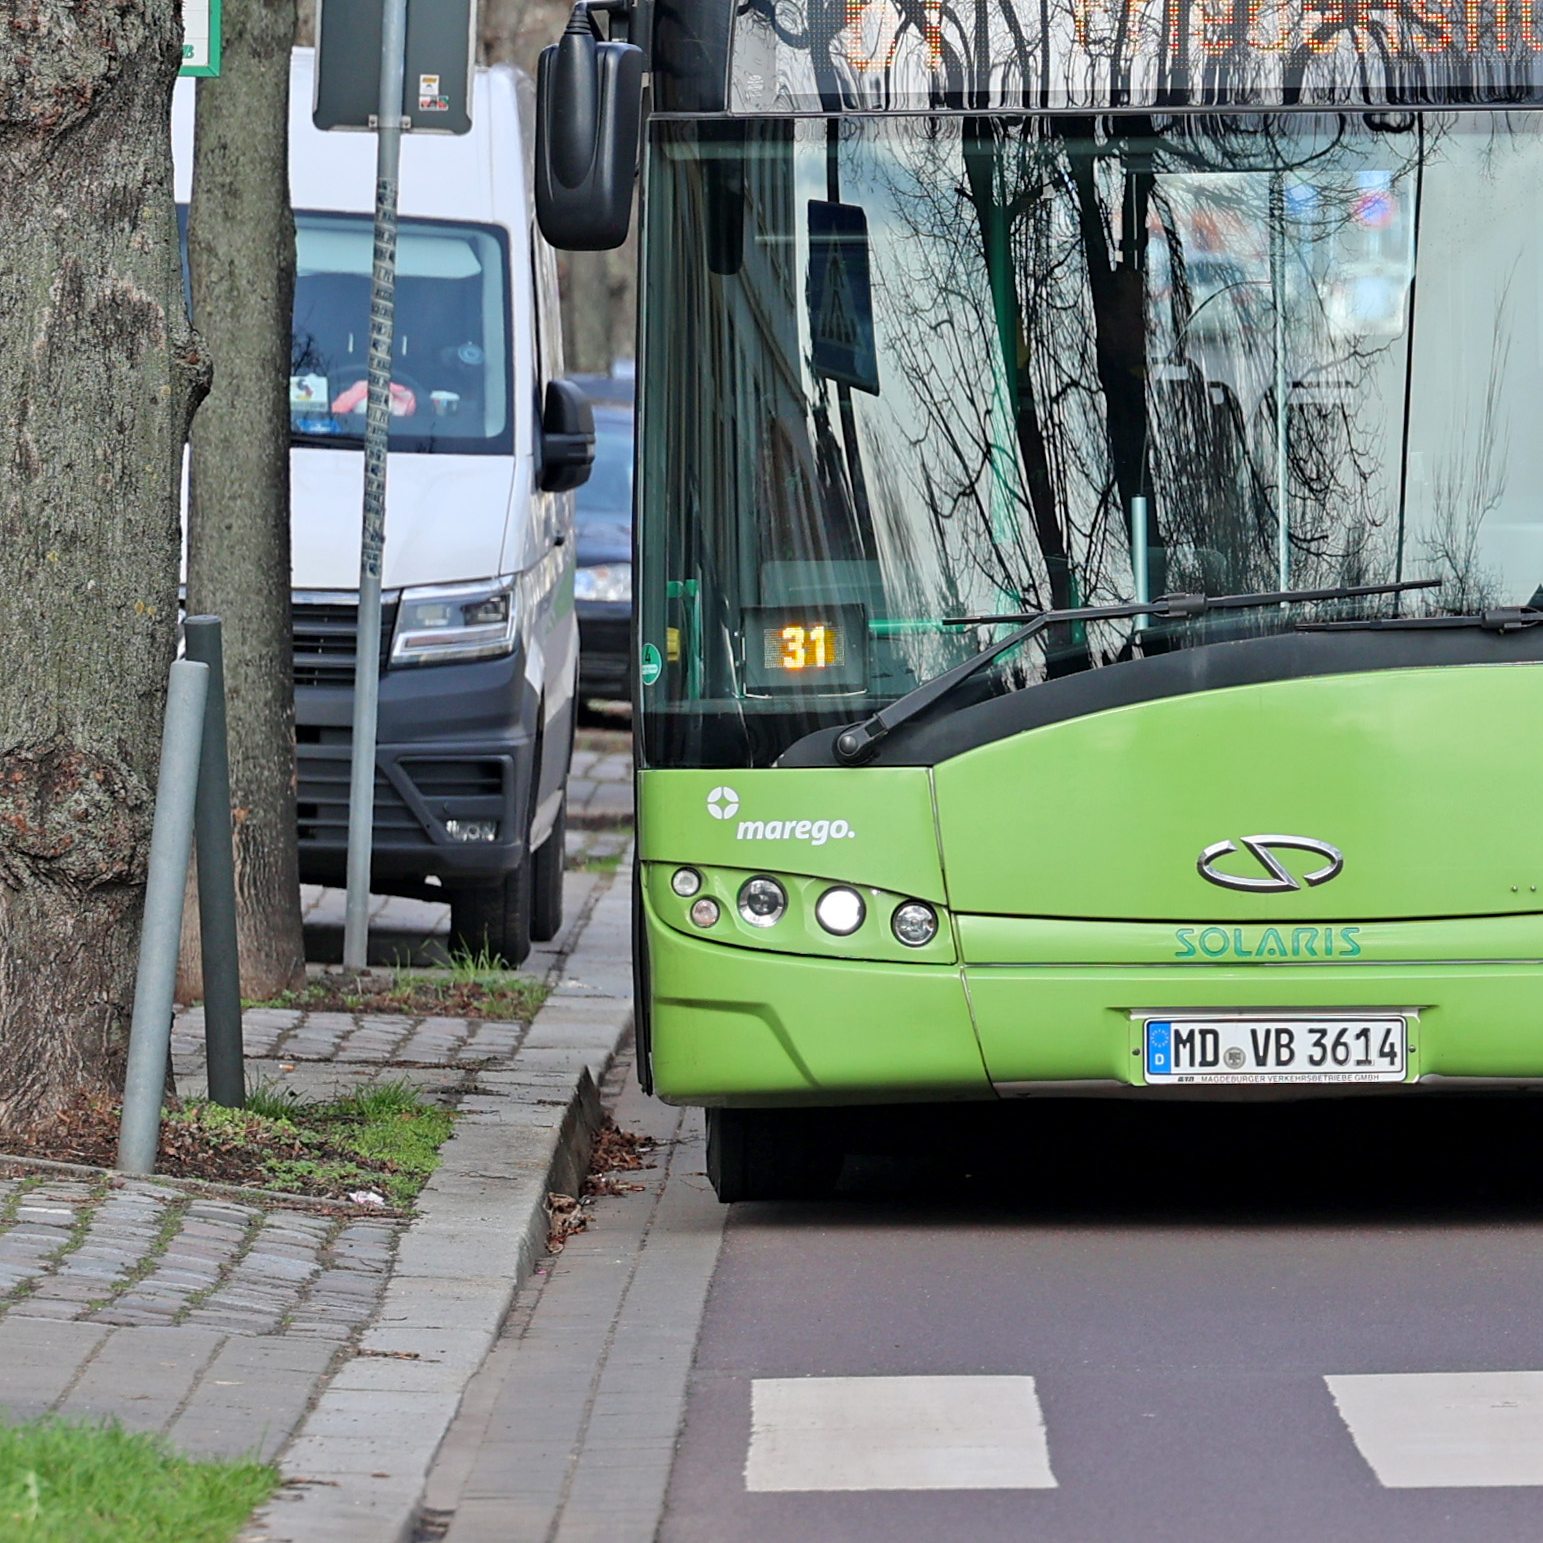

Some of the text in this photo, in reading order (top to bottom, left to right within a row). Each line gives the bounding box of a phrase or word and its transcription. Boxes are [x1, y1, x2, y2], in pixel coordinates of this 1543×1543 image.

[782, 625, 825, 669] 31
[737, 819, 856, 846] marego.
[1175, 927, 1361, 957] SOLARIS
[1154, 1054, 1165, 1066] D
[1174, 1027, 1397, 1067] MD VB 3614
[1201, 1075, 1266, 1083] MAGDEBURGER
